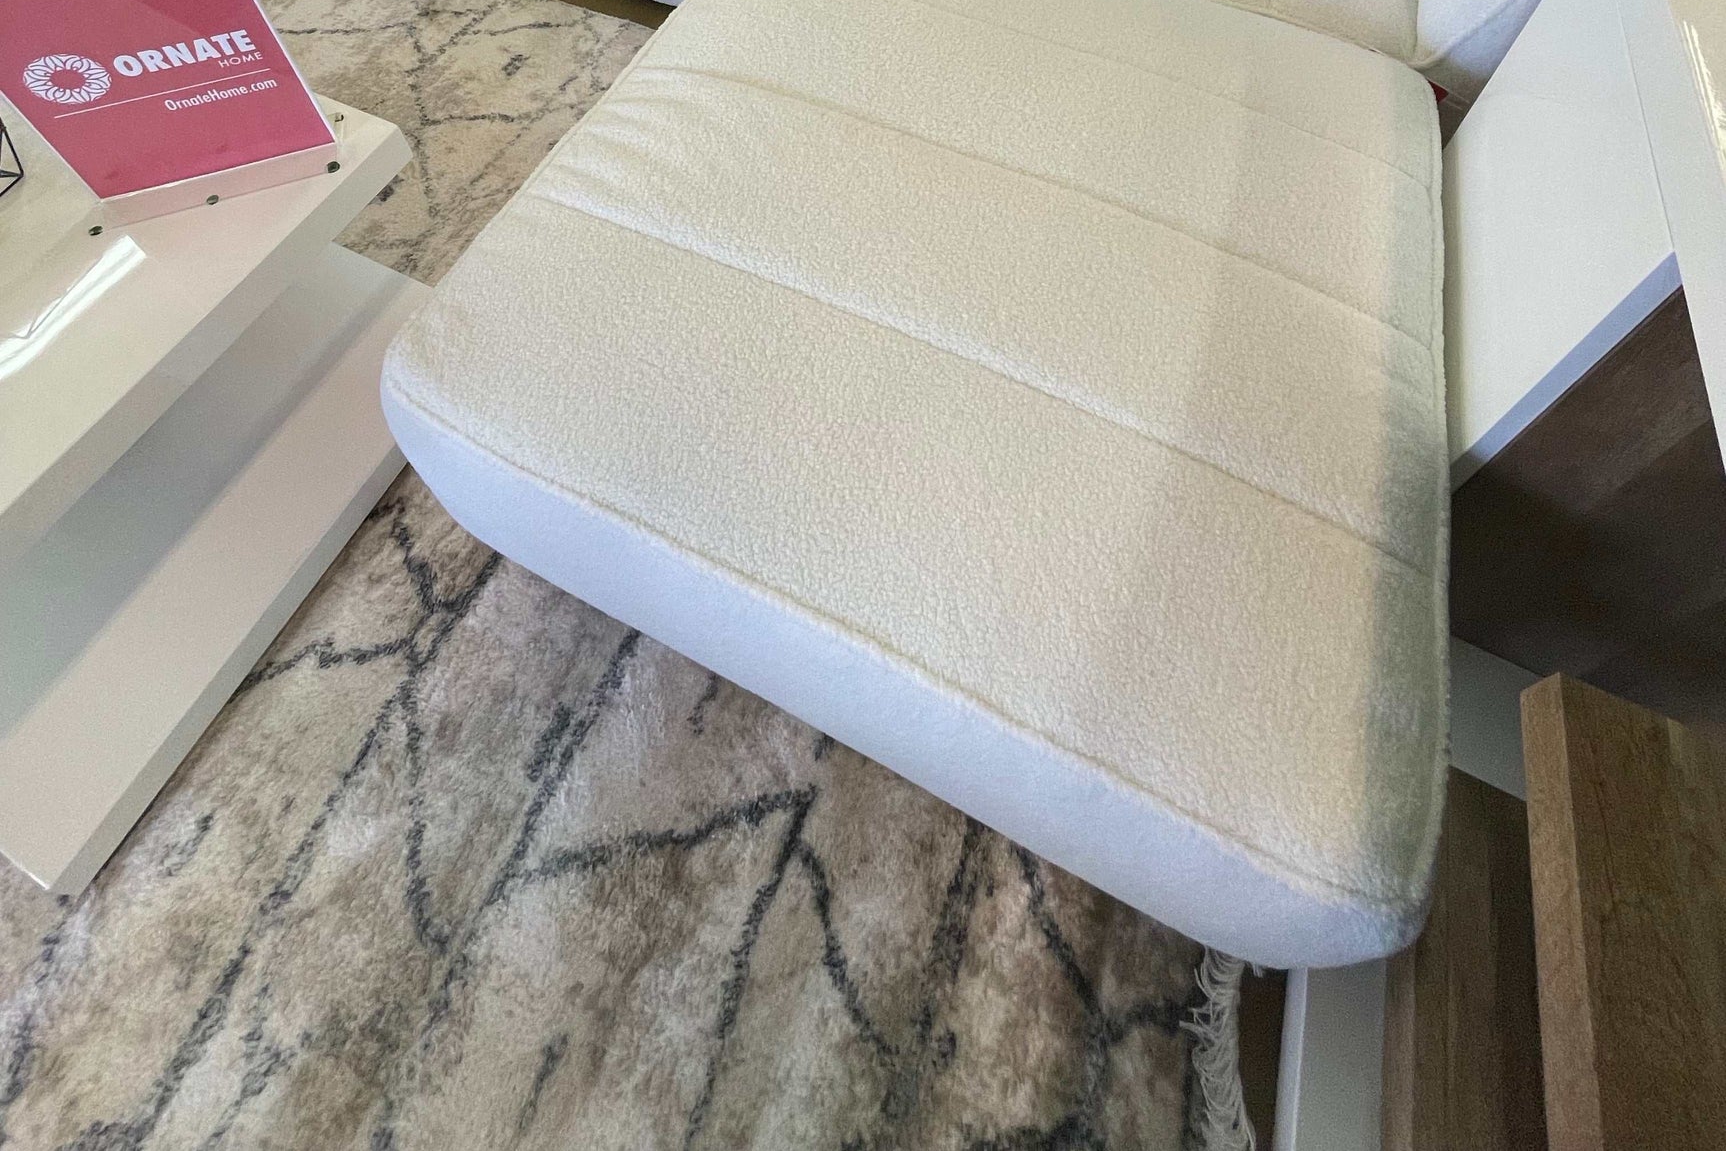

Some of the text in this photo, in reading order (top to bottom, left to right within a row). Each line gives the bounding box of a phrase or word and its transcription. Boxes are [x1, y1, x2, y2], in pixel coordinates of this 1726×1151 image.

[113, 29, 257, 78] ORNATE
[218, 50, 264, 68] HOME
[164, 77, 278, 112] OrnateHome.com
